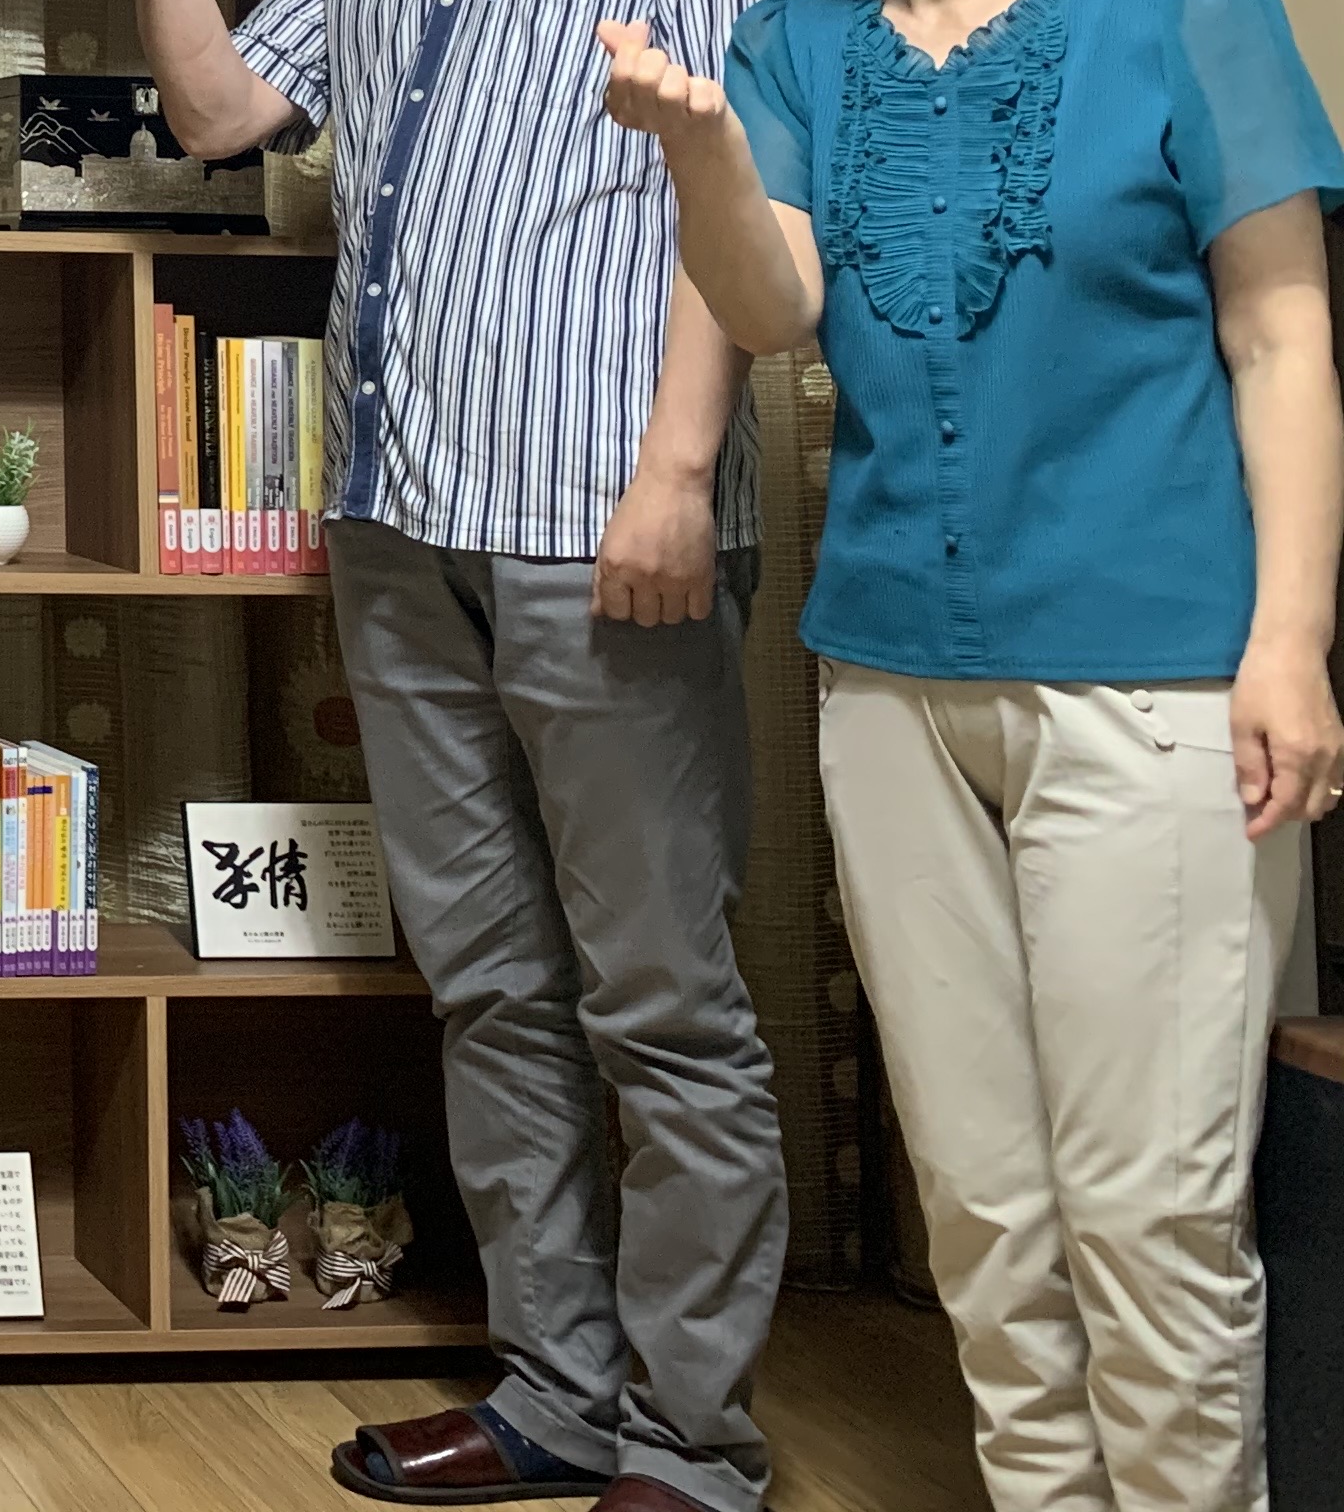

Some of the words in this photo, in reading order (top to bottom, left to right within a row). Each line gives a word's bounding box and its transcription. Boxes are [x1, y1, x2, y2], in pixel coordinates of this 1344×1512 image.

[182, 327, 191, 350] Divine
[183, 351, 192, 384] Principle
[250, 357, 258, 387] GUIDANCE
[270, 359, 279, 389] GUIDANCE
[288, 357, 296, 387] GUIDANCE
[184, 386, 193, 413] Lecture
[250, 398, 258, 428] HEAVENLY
[288, 398, 296, 428] HEAVENLY
[184, 415, 193, 442] Manual
[270, 400, 279, 430] HEAVENLY
[250, 430, 258, 462] TRADITION
[270, 432, 279, 464] TRADITION
[288, 430, 296, 462] TRADITION
[208, 527, 216, 550] English
